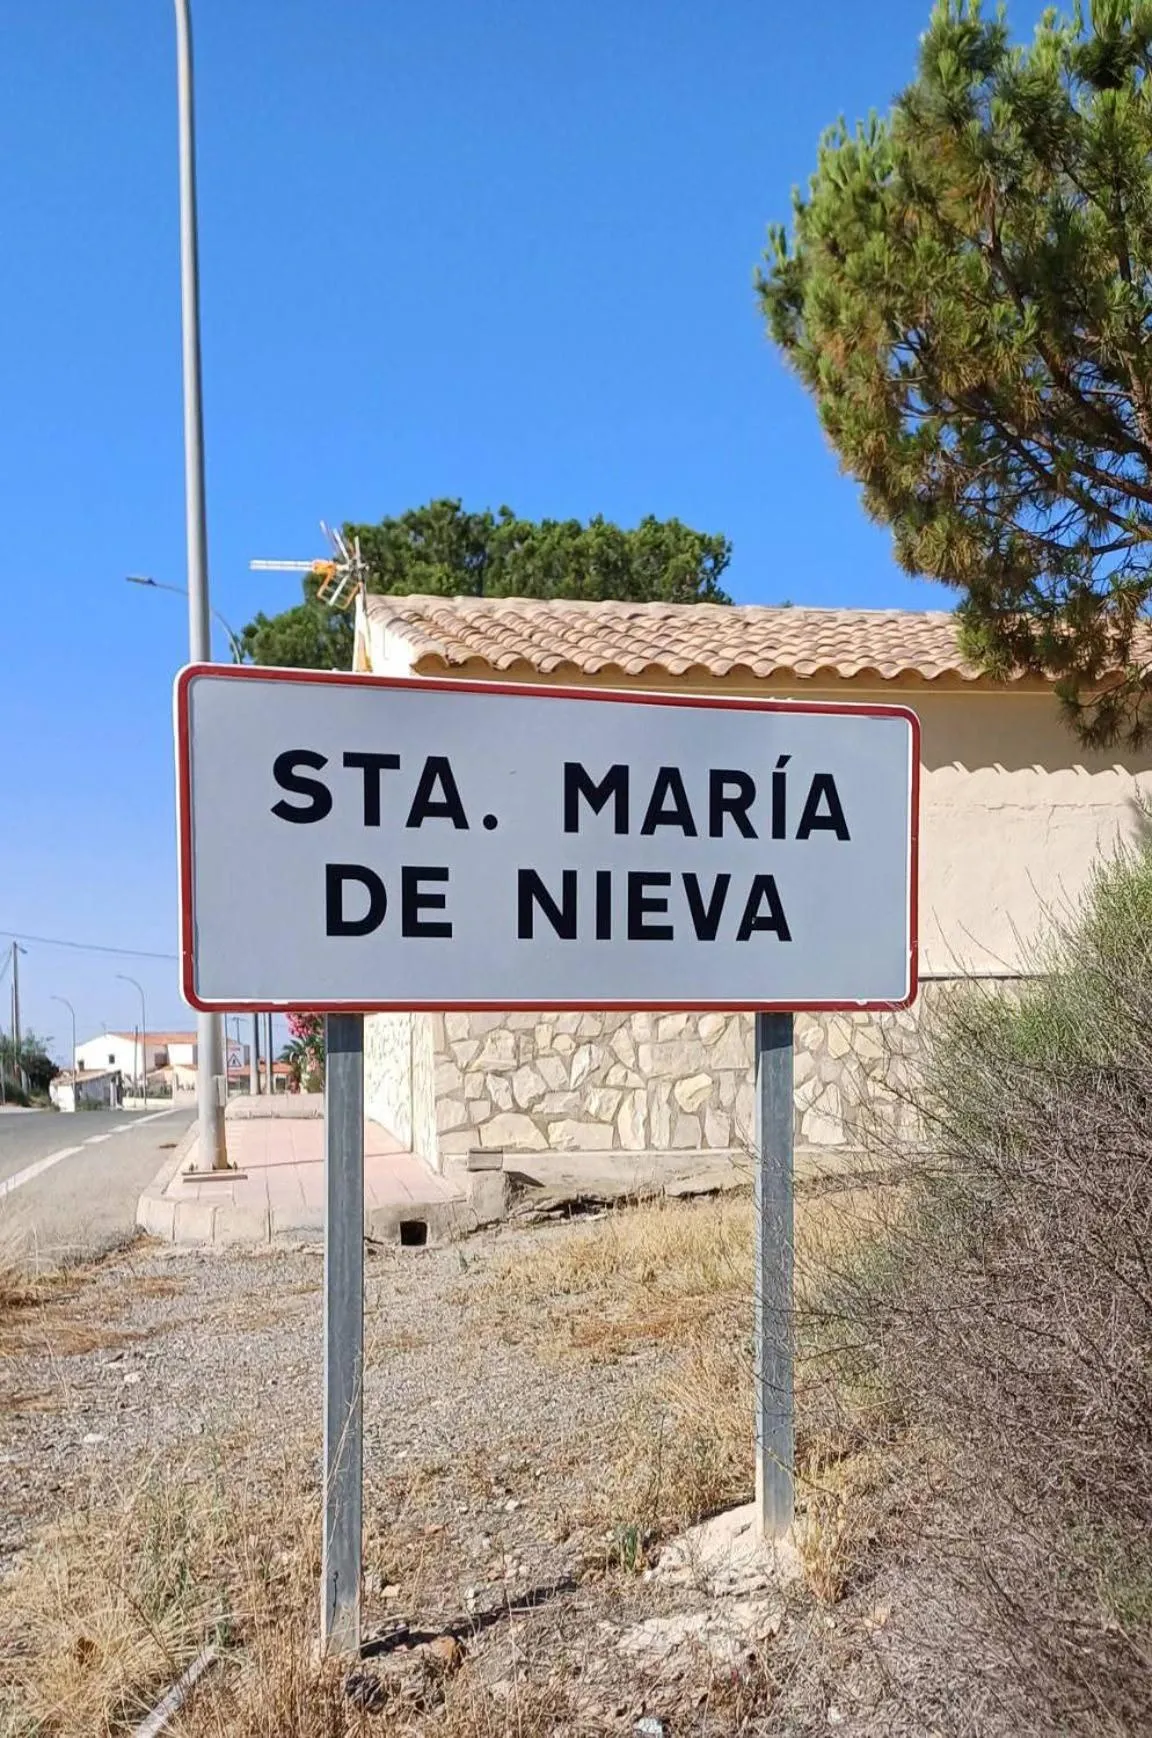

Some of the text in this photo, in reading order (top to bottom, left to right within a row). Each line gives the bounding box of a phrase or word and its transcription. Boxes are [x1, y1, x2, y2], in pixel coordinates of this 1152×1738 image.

[271, 749, 851, 841] STA. MARÍA
[326, 863, 793, 942] DE NIEVA
